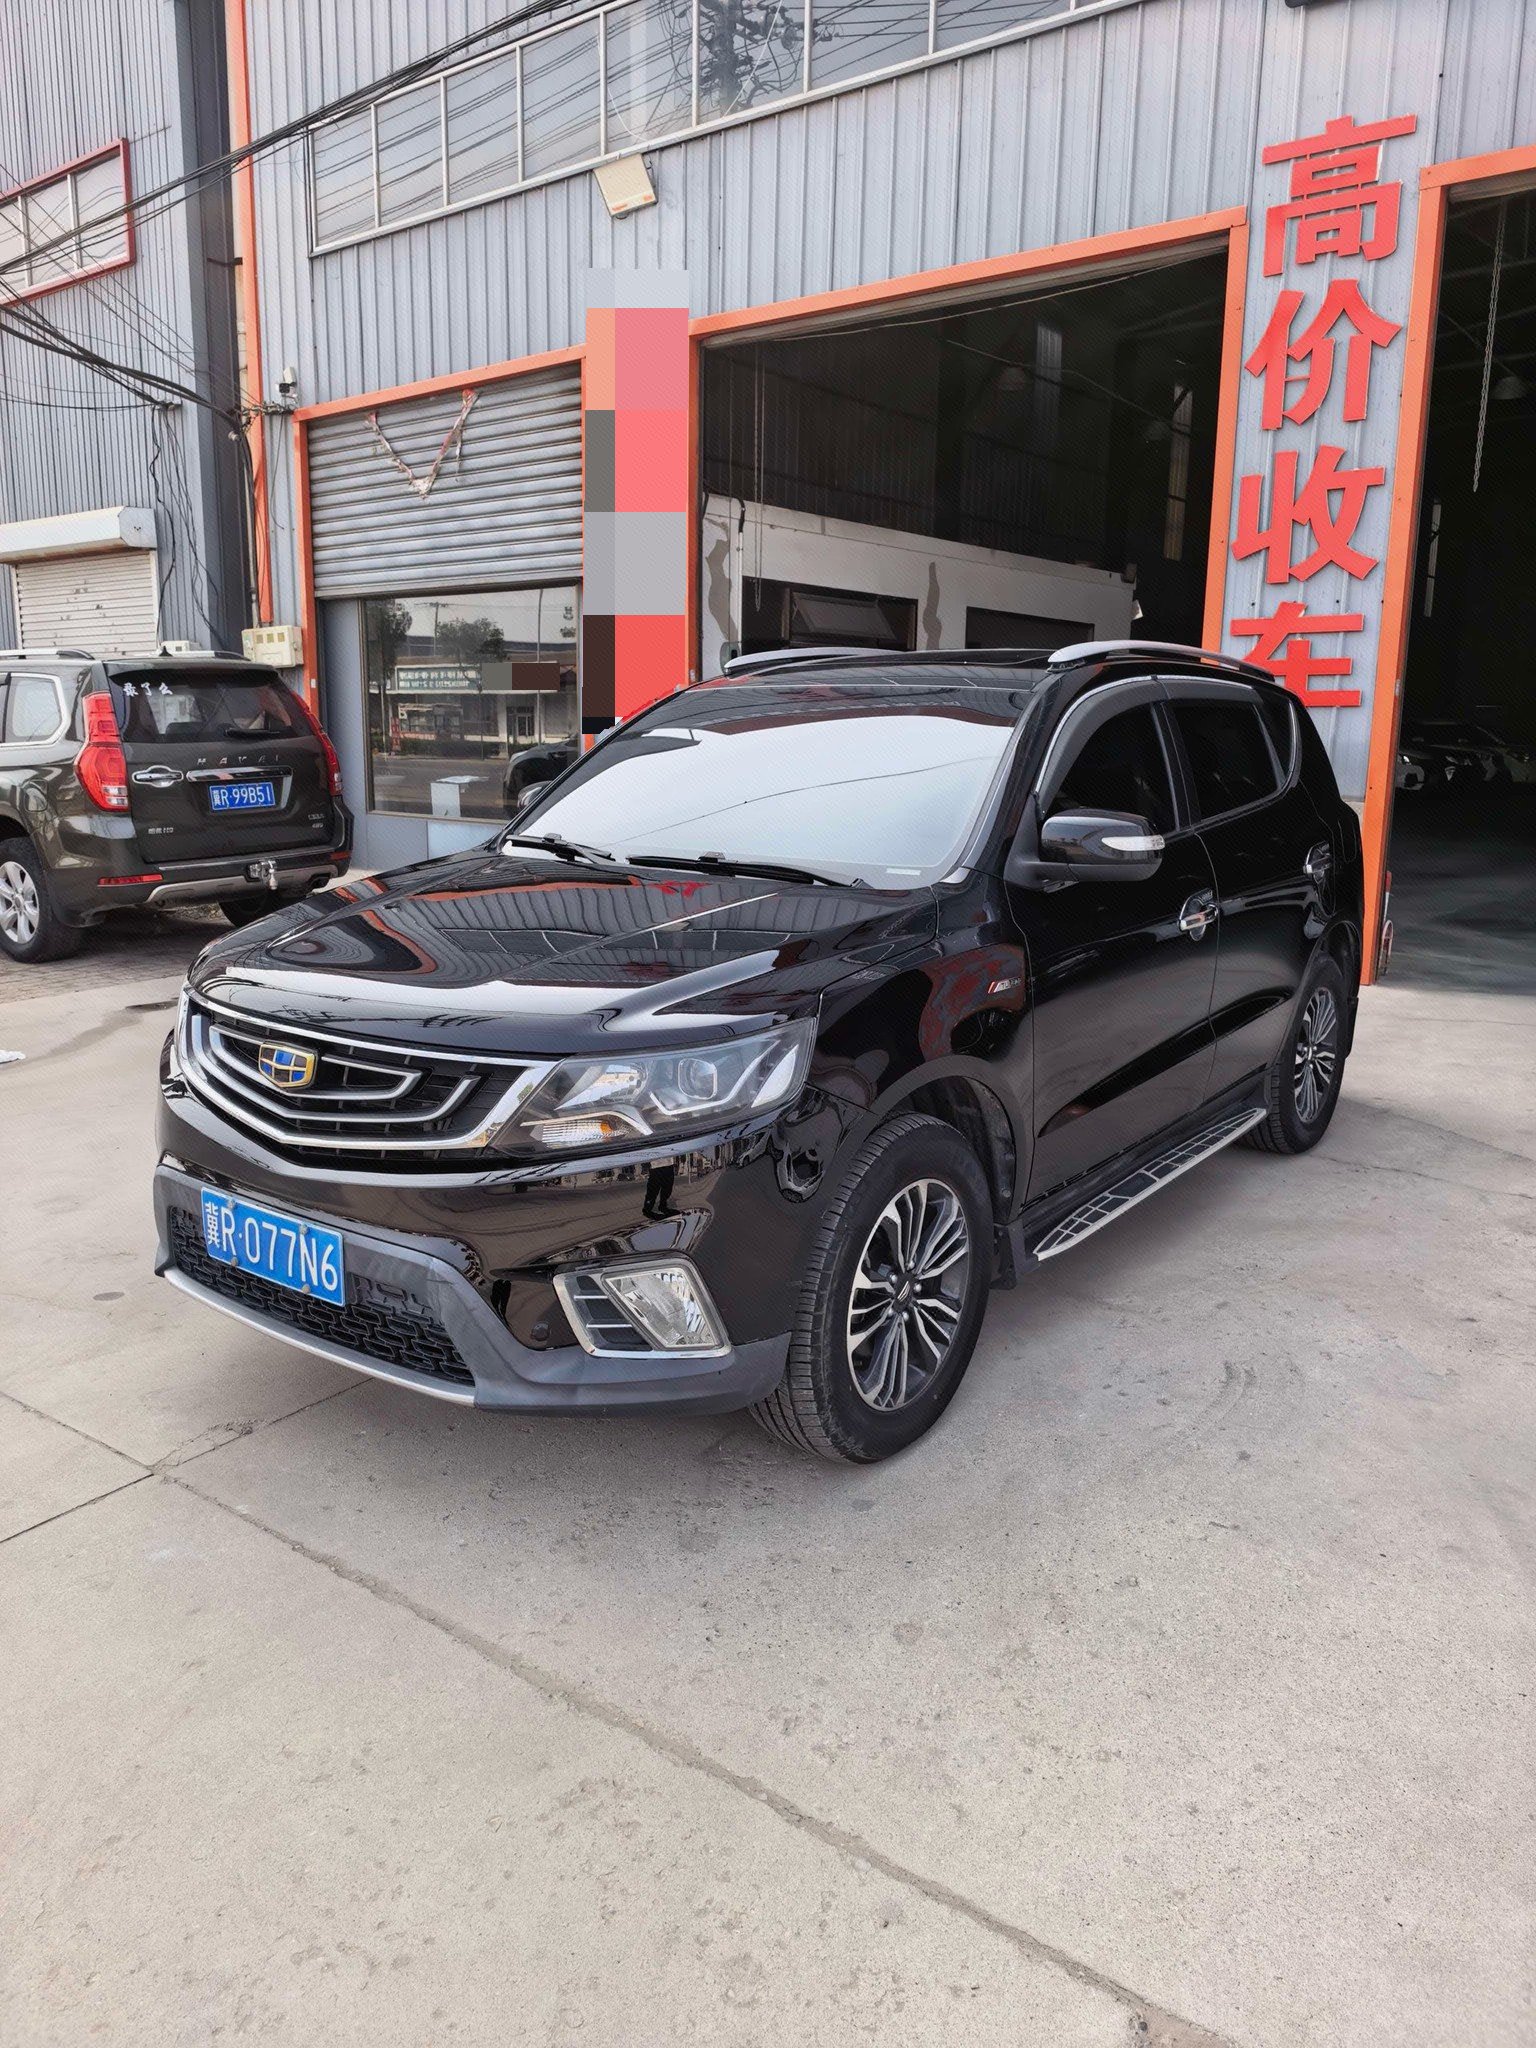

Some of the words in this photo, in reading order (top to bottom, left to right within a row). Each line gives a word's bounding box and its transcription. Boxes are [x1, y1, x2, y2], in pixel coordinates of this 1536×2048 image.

[1231, 114, 1418, 708] 高价收车
[204, 1200, 339, 1292] 冀R·077N6
